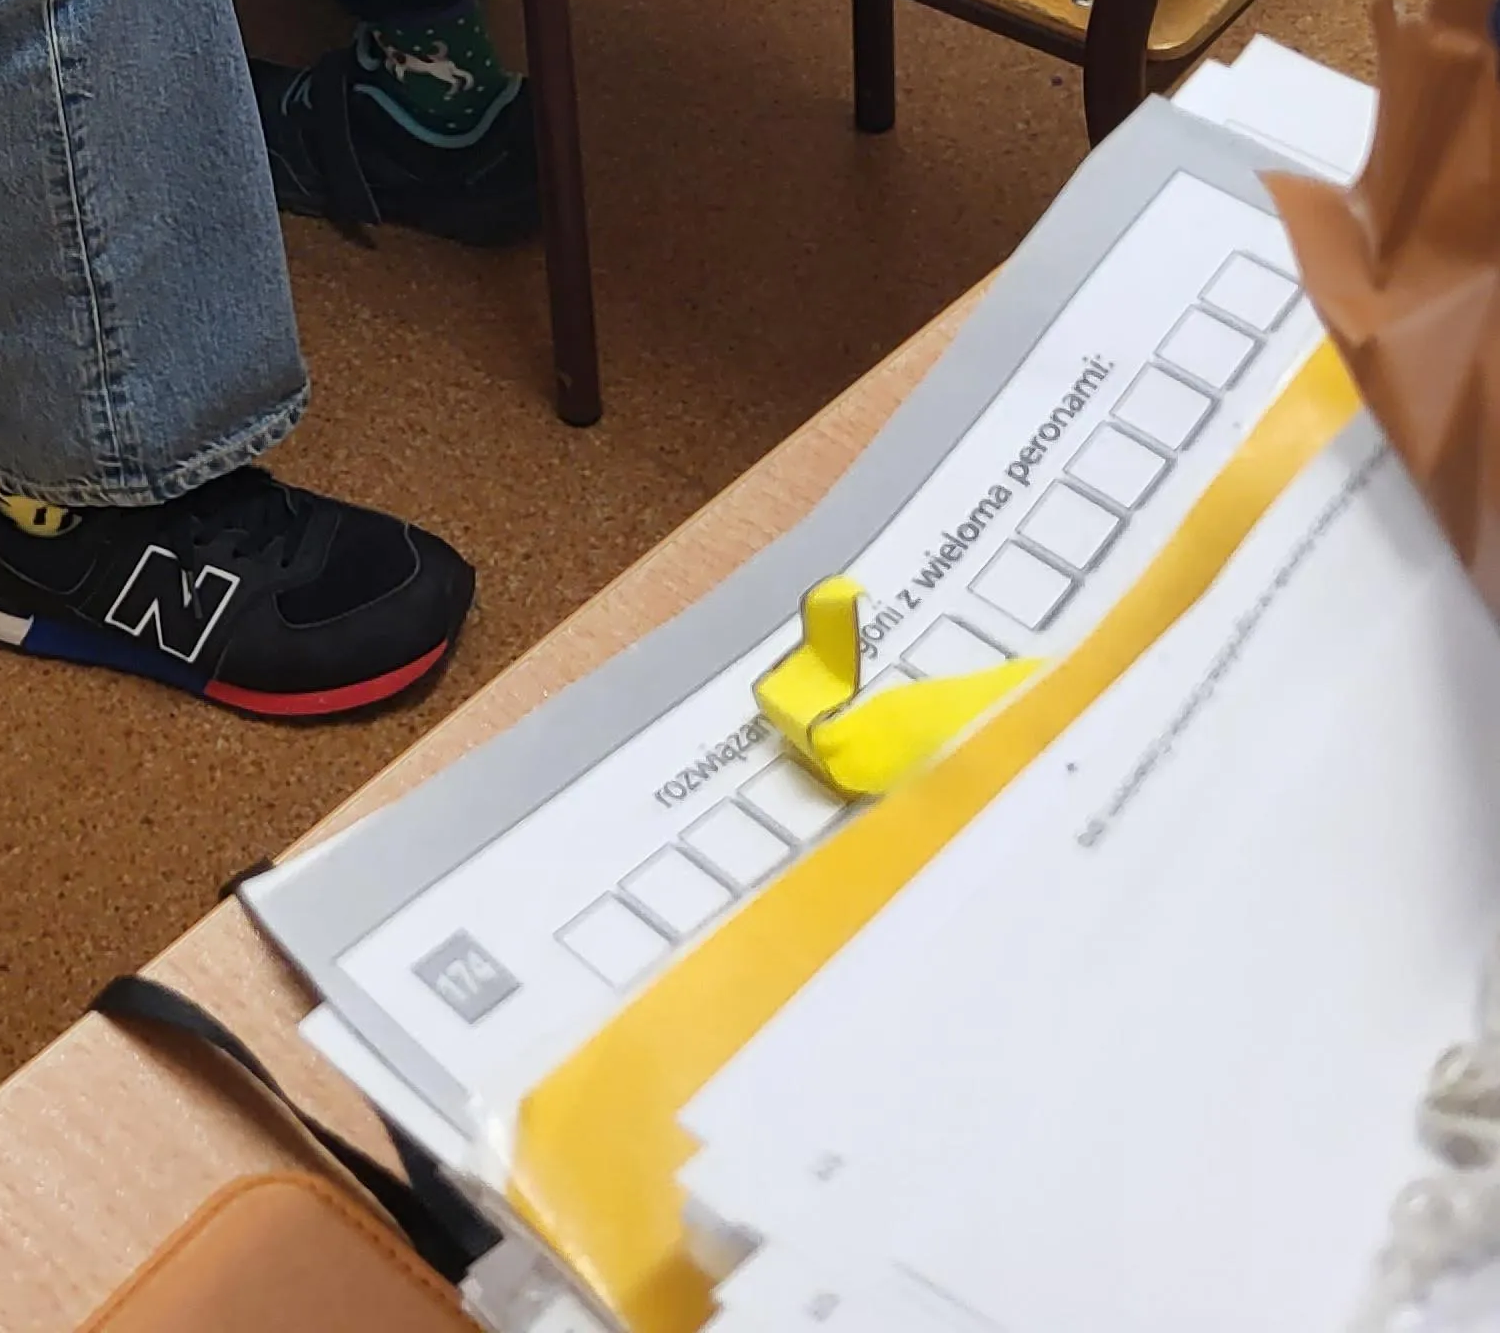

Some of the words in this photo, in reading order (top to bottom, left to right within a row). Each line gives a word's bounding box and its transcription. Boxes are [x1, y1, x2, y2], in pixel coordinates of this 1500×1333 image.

[104, 543, 241, 665] N
[654, 713, 772, 808] rozwiązan
[896, 588, 923, 610] z
[912, 483, 1013, 590] wieloma
[1005, 353, 1116, 487] peronami:
